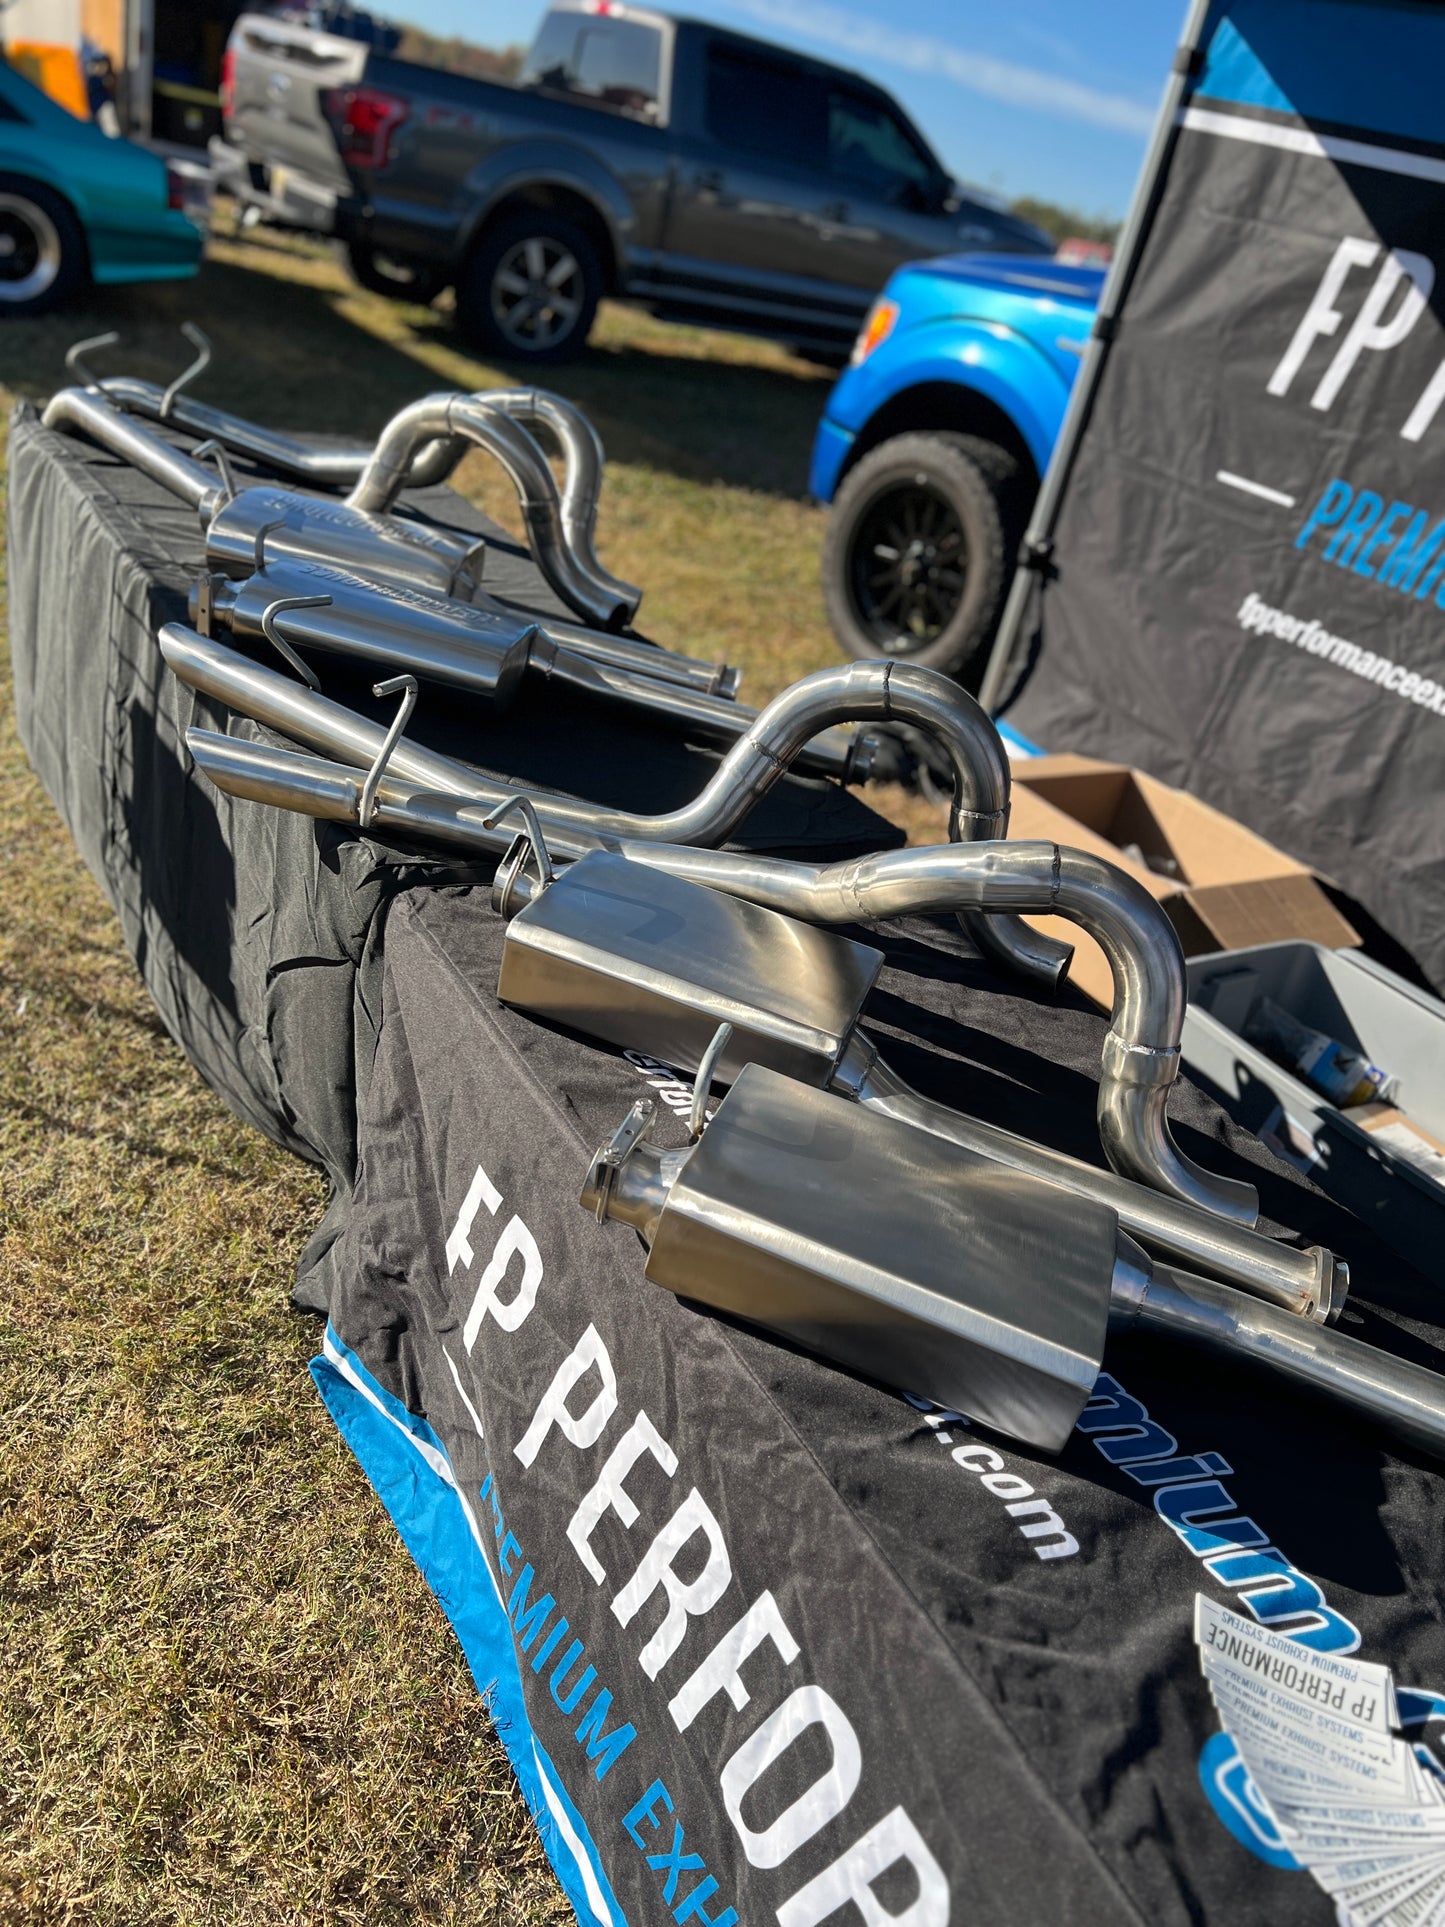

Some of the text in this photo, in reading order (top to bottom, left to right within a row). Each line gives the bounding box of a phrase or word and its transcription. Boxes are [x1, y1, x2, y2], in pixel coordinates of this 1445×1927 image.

[1267, 236, 1436, 412] FP
[1236, 592, 1445, 716] fpperformanceex
[445, 1164, 544, 1358] FP
[479, 1471, 639, 1781] EMIUM
[1206, 1622, 1347, 1710] PERFORMANCE
[1221, 1611, 1360, 1684] PREMIUM EXHAUST SYSTEMS
[1316, 1714, 1365, 1745] SYSTEMS
[1351, 1694, 1377, 1723] FP
